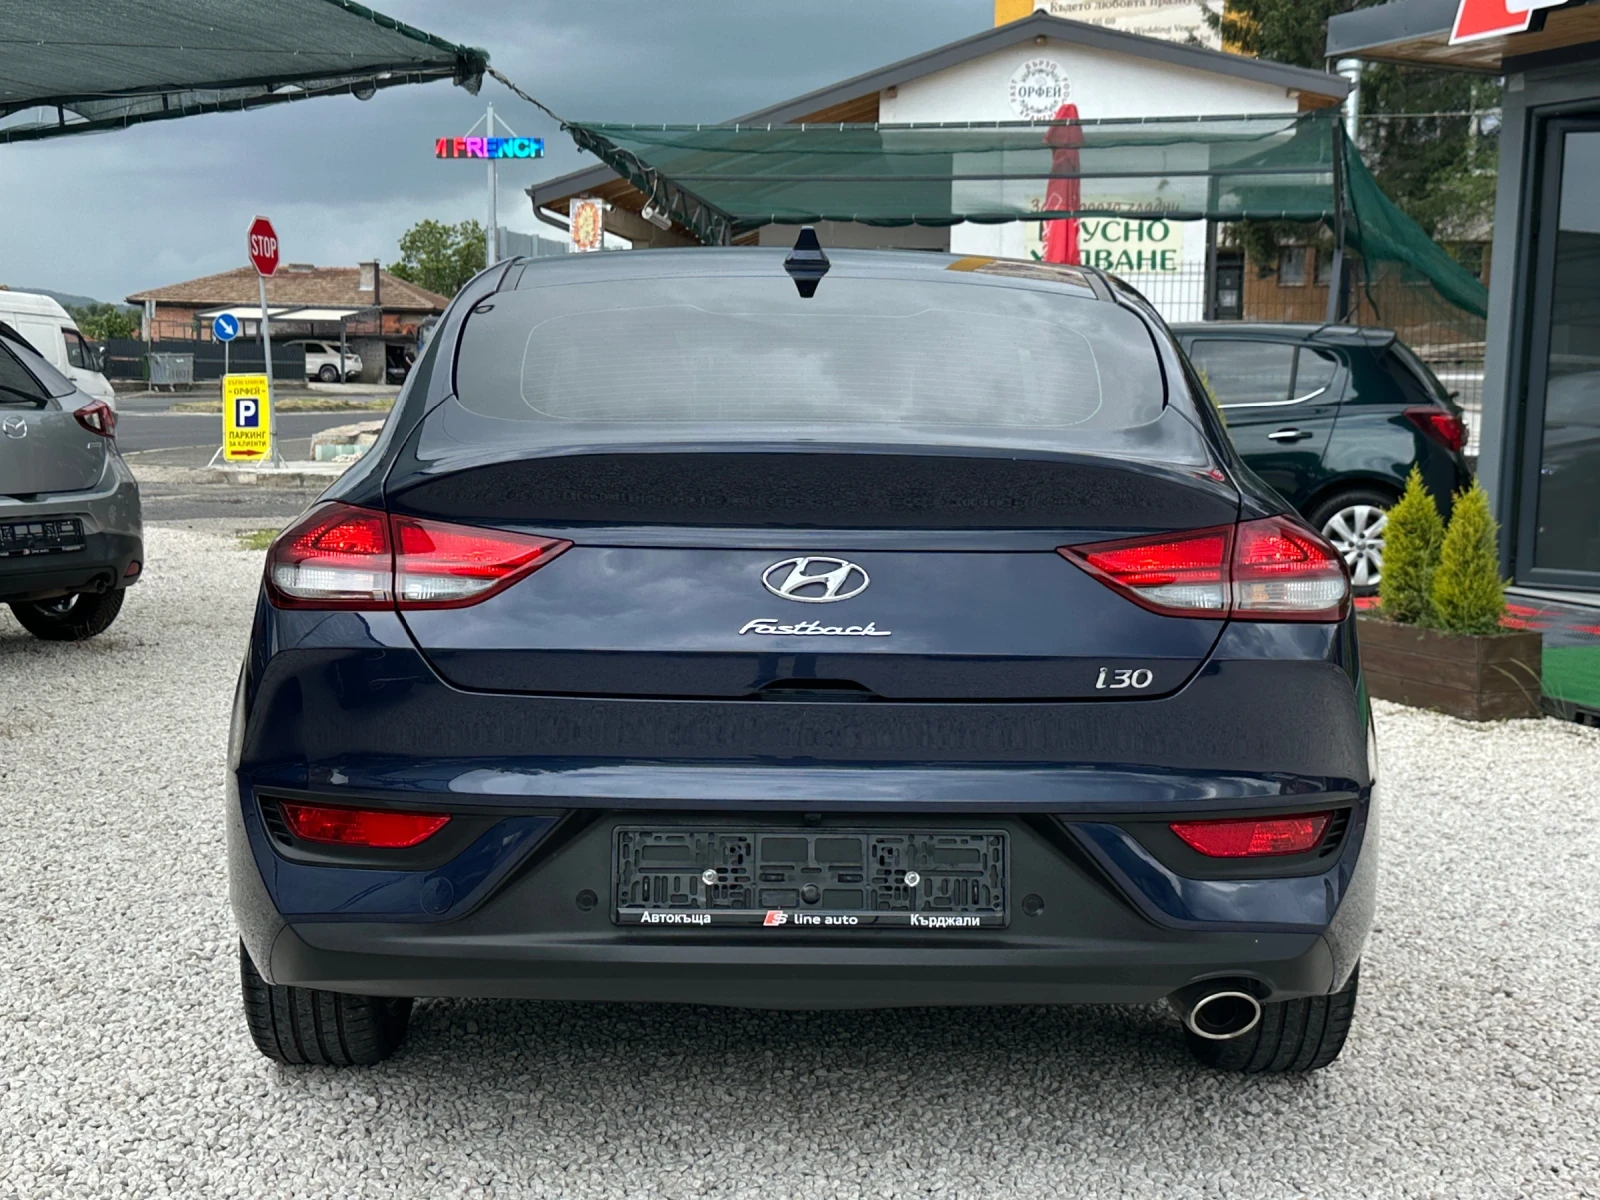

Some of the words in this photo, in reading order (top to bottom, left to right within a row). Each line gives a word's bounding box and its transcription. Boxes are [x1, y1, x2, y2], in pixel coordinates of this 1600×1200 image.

[1018, 83, 1061, 98] ОРФЕЙ
[453, 138, 544, 158] FRENCH
[1038, 220, 1170, 242] УСНО
[251, 234, 277, 258] STOP
[1030, 249, 1177, 271] ПВАНЕ
[233, 386, 260, 395] ОРФЕЙ
[229, 431, 266, 440] ПАРКИНГ
[738, 618, 892, 636] Fastback
[1095, 666, 1153, 690] i30
[640, 910, 712, 925] Автокъща
[794, 913, 820, 925] line
[825, 914, 858, 925] auto
[910, 914, 981, 928] Кърджали
